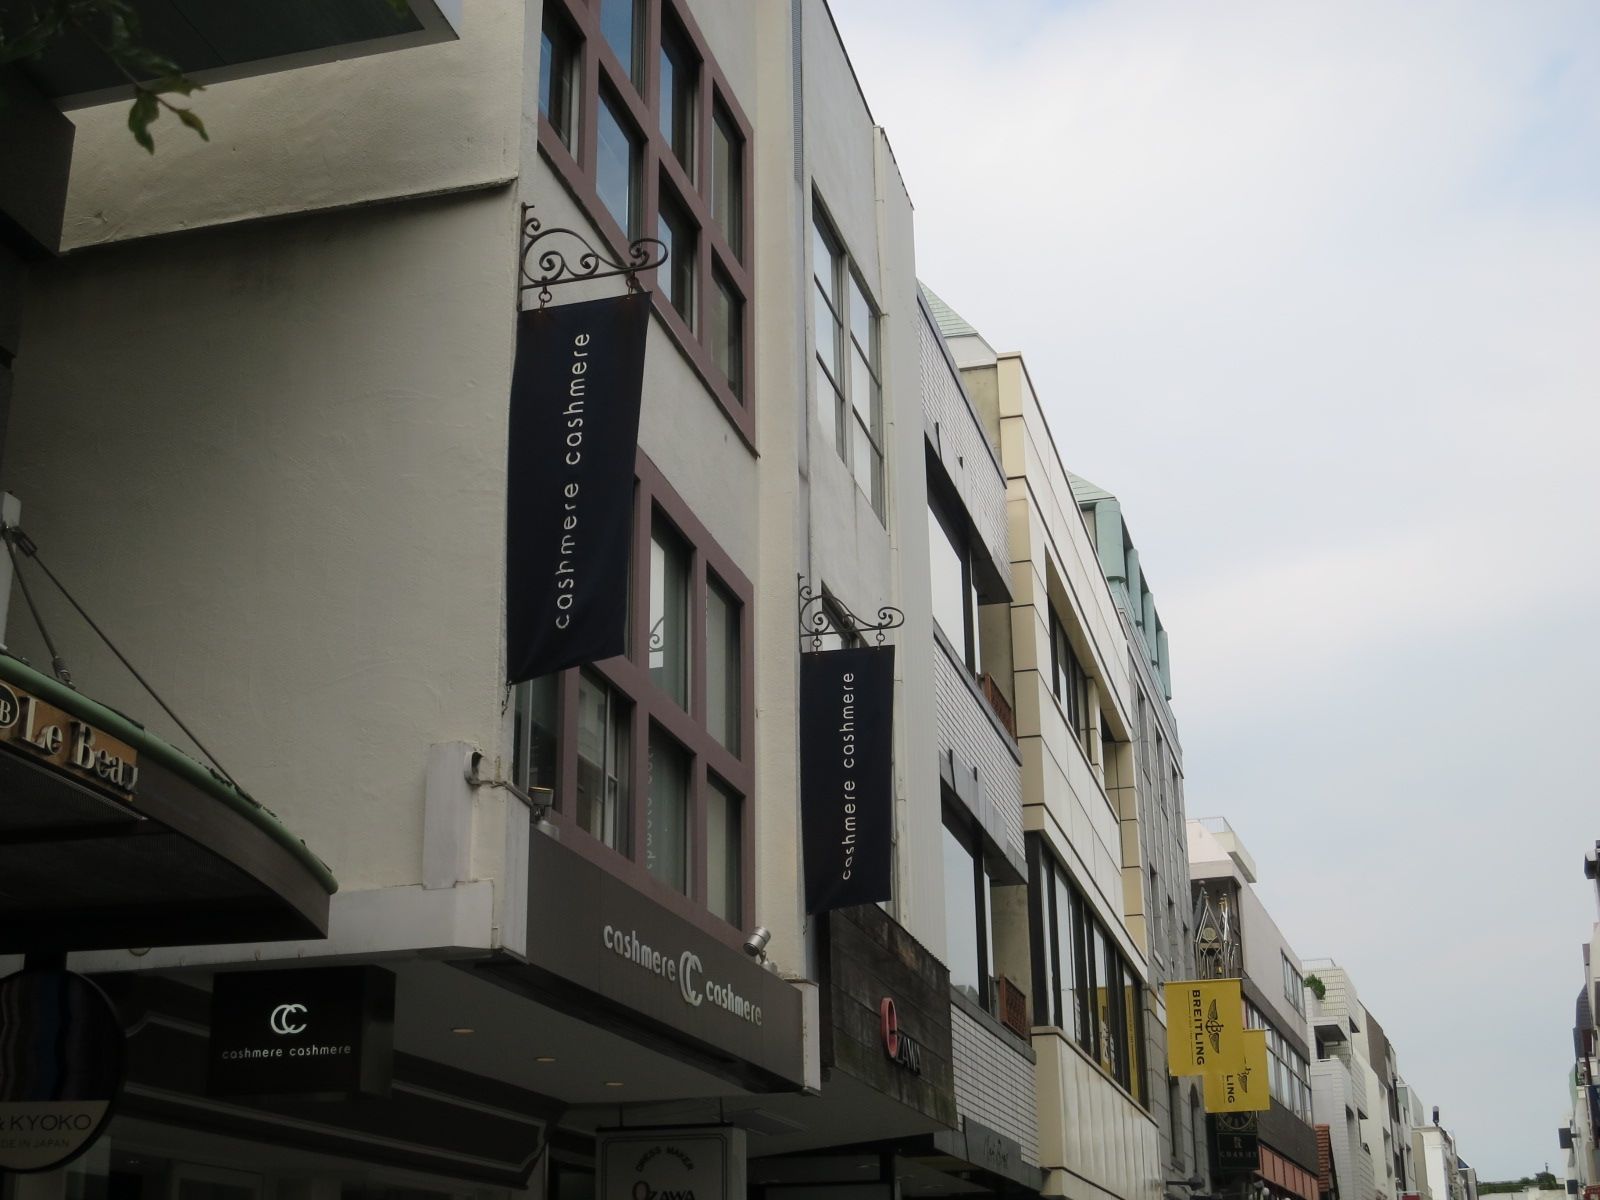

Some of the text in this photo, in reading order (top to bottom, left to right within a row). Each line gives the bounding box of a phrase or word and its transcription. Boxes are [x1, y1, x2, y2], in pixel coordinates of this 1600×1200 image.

[555, 333, 590, 629] cashmere cashmere
[21, 695, 63, 754] Le
[839, 672, 856, 880] cashmere cashmere
[603, 925, 676, 981] cashmere
[706, 980, 762, 1026] cashmere
[222, 1044, 352, 1059] cashmere cashmere
[1192, 989, 1205, 1066] BREITLING
[9, 1114, 92, 1131] KYOKO
[666, 1146, 694, 1170] MAKER
